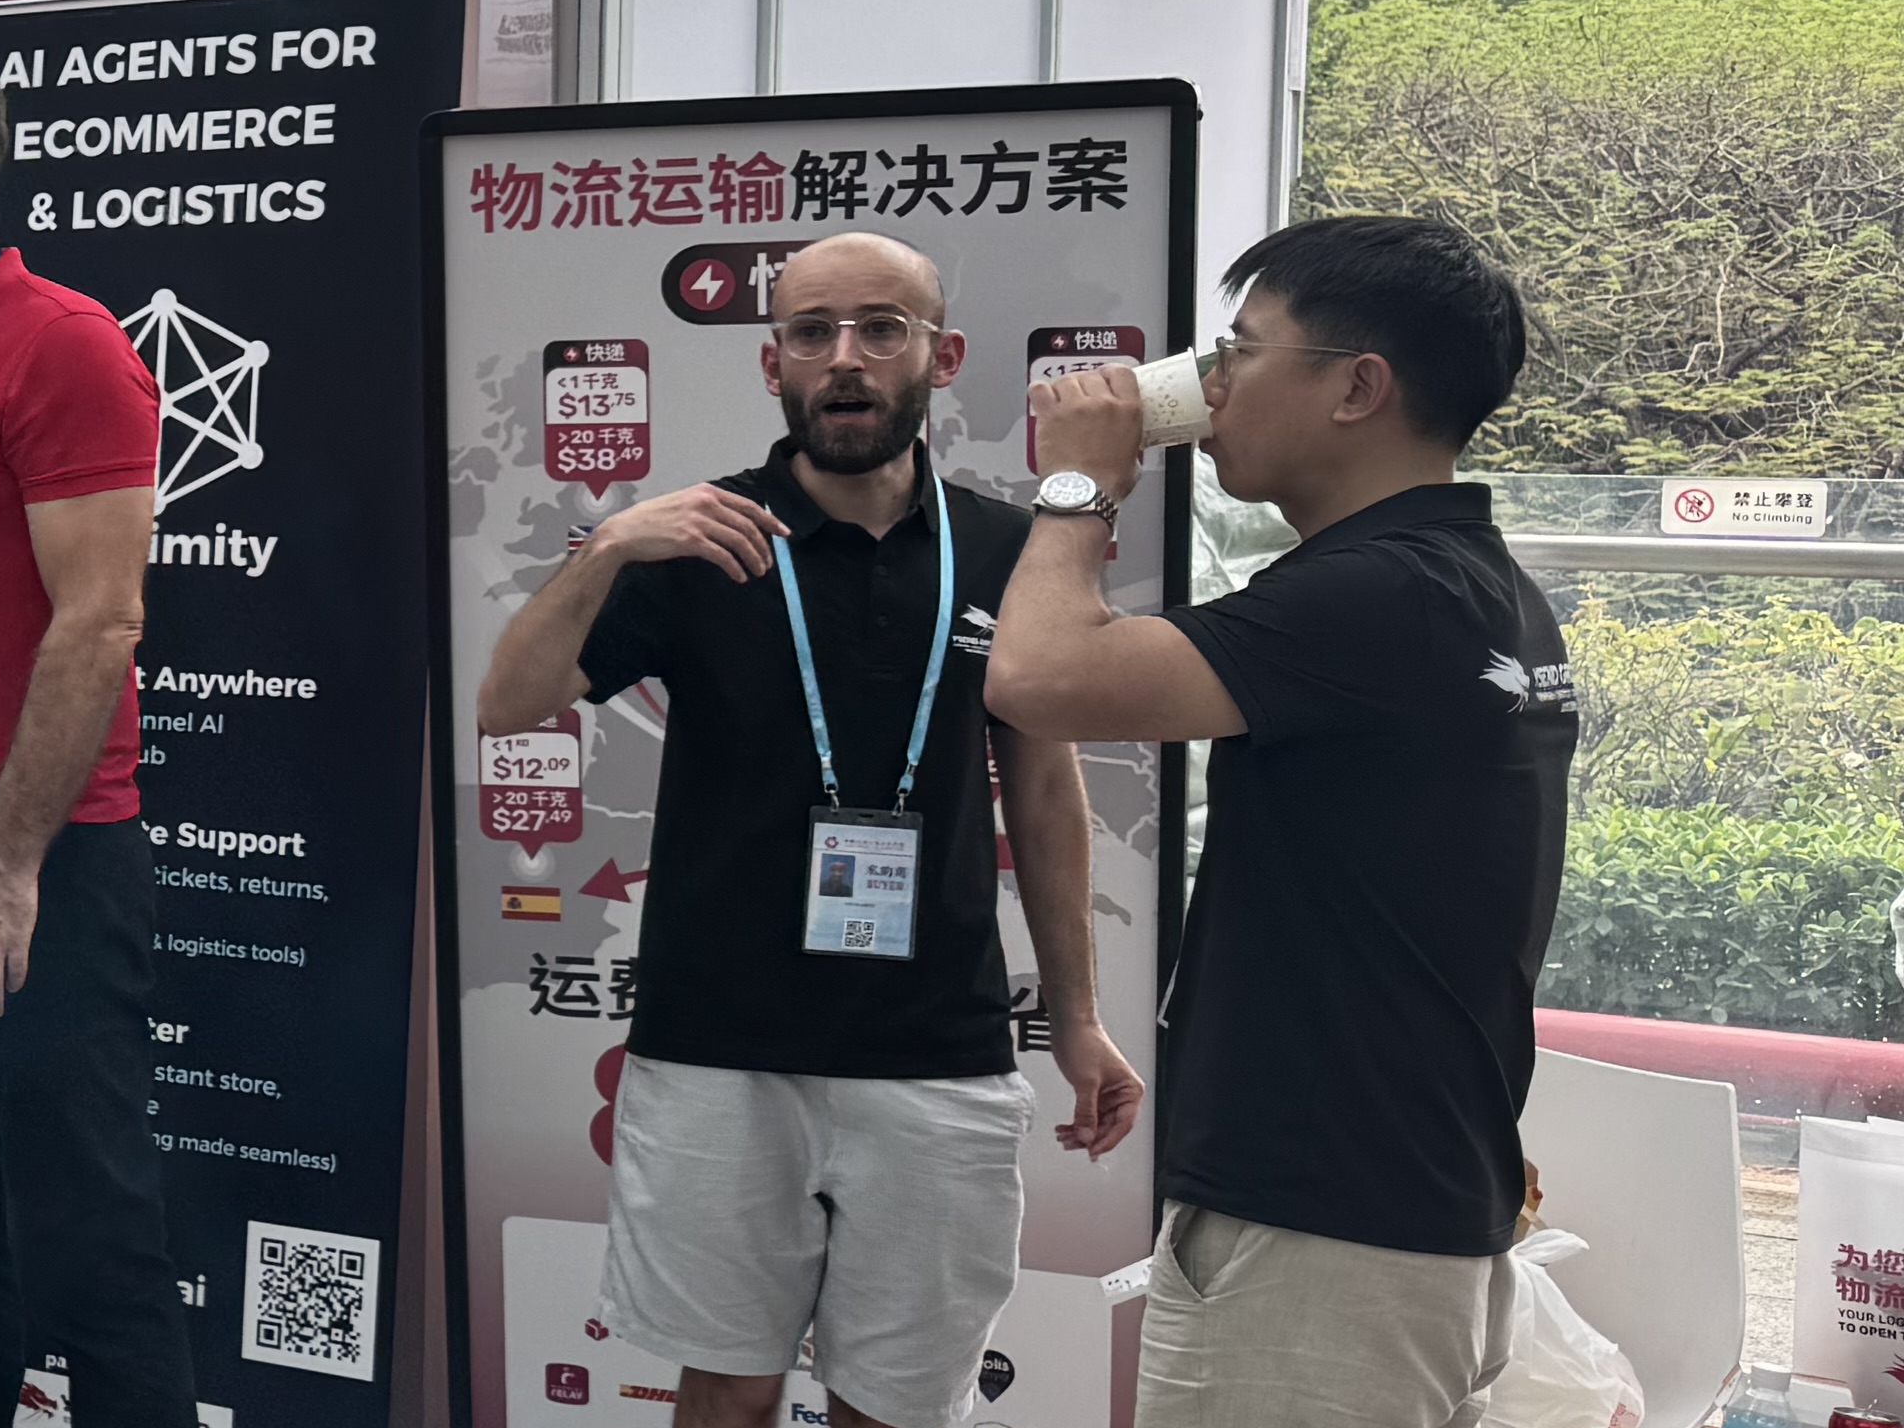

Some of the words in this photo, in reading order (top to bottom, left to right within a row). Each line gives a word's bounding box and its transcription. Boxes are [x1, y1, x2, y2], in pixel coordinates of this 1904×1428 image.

[56, 33, 258, 87] AGENTS
[271, 25, 377, 72] FOR
[14, 103, 336, 161] ECOMMERCE
[469, 137, 1130, 234] 物流运输解决方案
[27, 192, 58, 231] &
[71, 179, 327, 231] LOGISTICS
[585, 343, 626, 362] 快递
[1075, 330, 1118, 350] 快递
[1734, 491, 1813, 508] 禁止攀登
[1732, 512, 1749, 522] No
[1754, 513, 1813, 525] Climbing
[149, 523, 279, 578] imity
[153, 666, 318, 700] Anywhere
[138, 712, 193, 733] nnel
[199, 714, 224, 734] AI
[176, 822, 308, 859] Support
[239, 876, 329, 903] returns,
[168, 933, 247, 959] logistics
[251, 944, 306, 968] tools)
[154, 1065, 215, 1088] stant
[219, 1072, 282, 1100] store,
[179, 1136, 235, 1157] made
[239, 1145, 337, 1174] seamless)
[1838, 1307, 1875, 1323] YOUR
[1838, 1322, 1856, 1333] TO
[1859, 1325, 1897, 1340] OPEN
